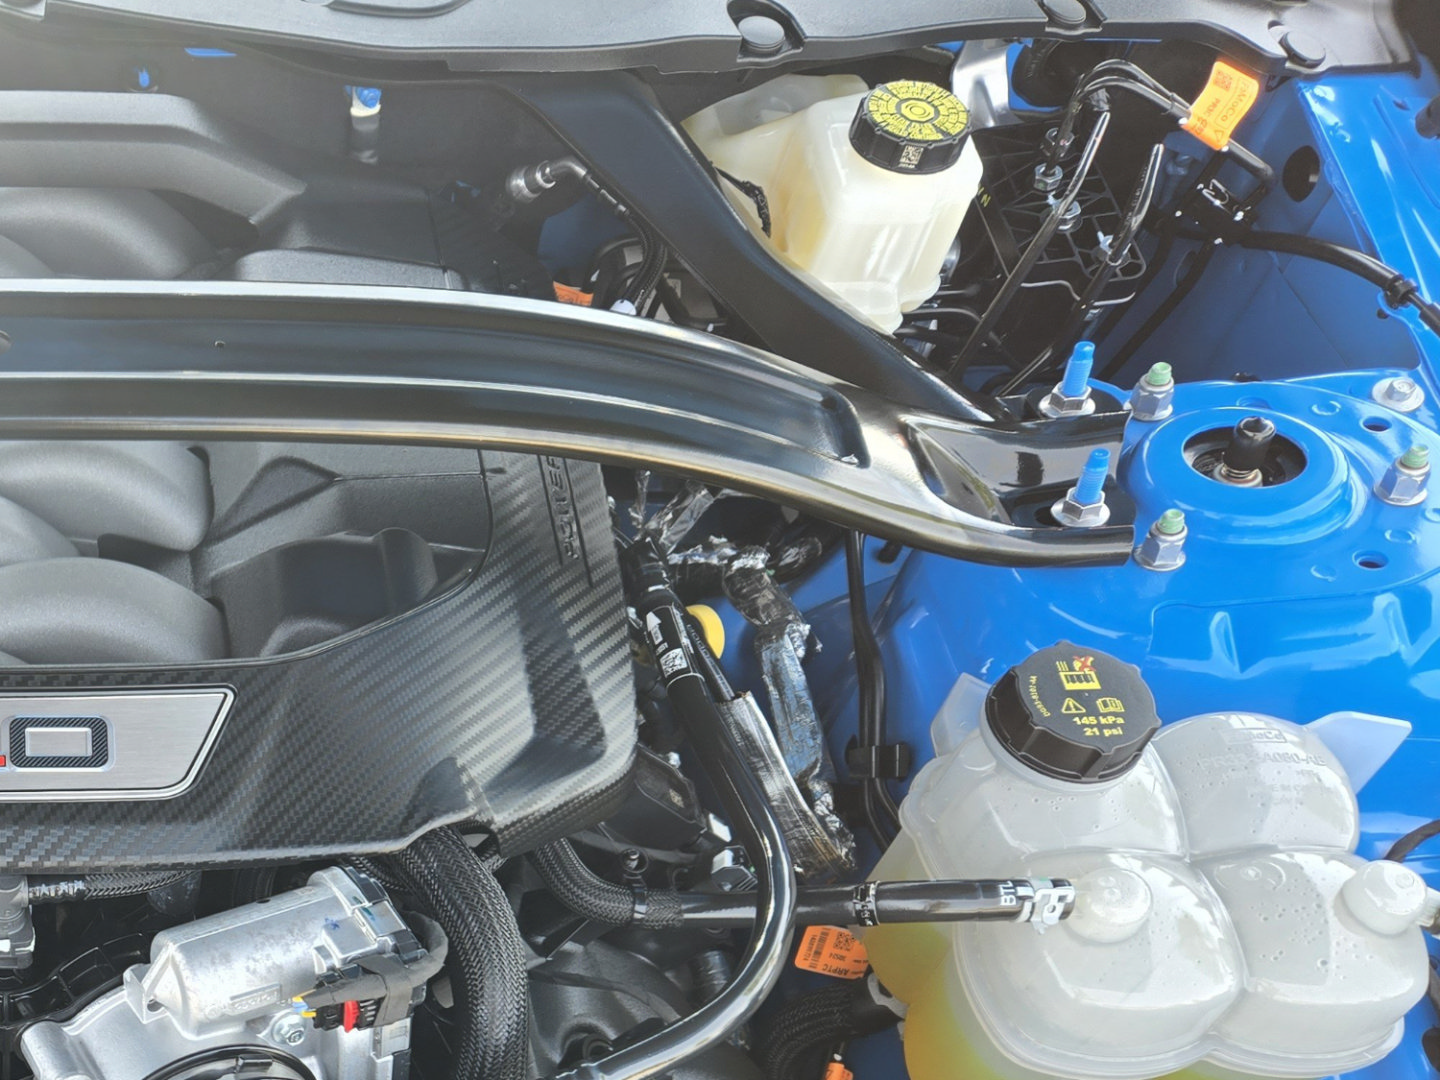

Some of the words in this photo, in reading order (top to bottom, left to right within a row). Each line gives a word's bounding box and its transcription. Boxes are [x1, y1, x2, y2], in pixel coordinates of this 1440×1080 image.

[1072, 716, 1098, 725] 145
[1099, 715, 1125, 724] kPa
[1083, 727, 1100, 736] 21
[1103, 727, 1123, 737] psi
